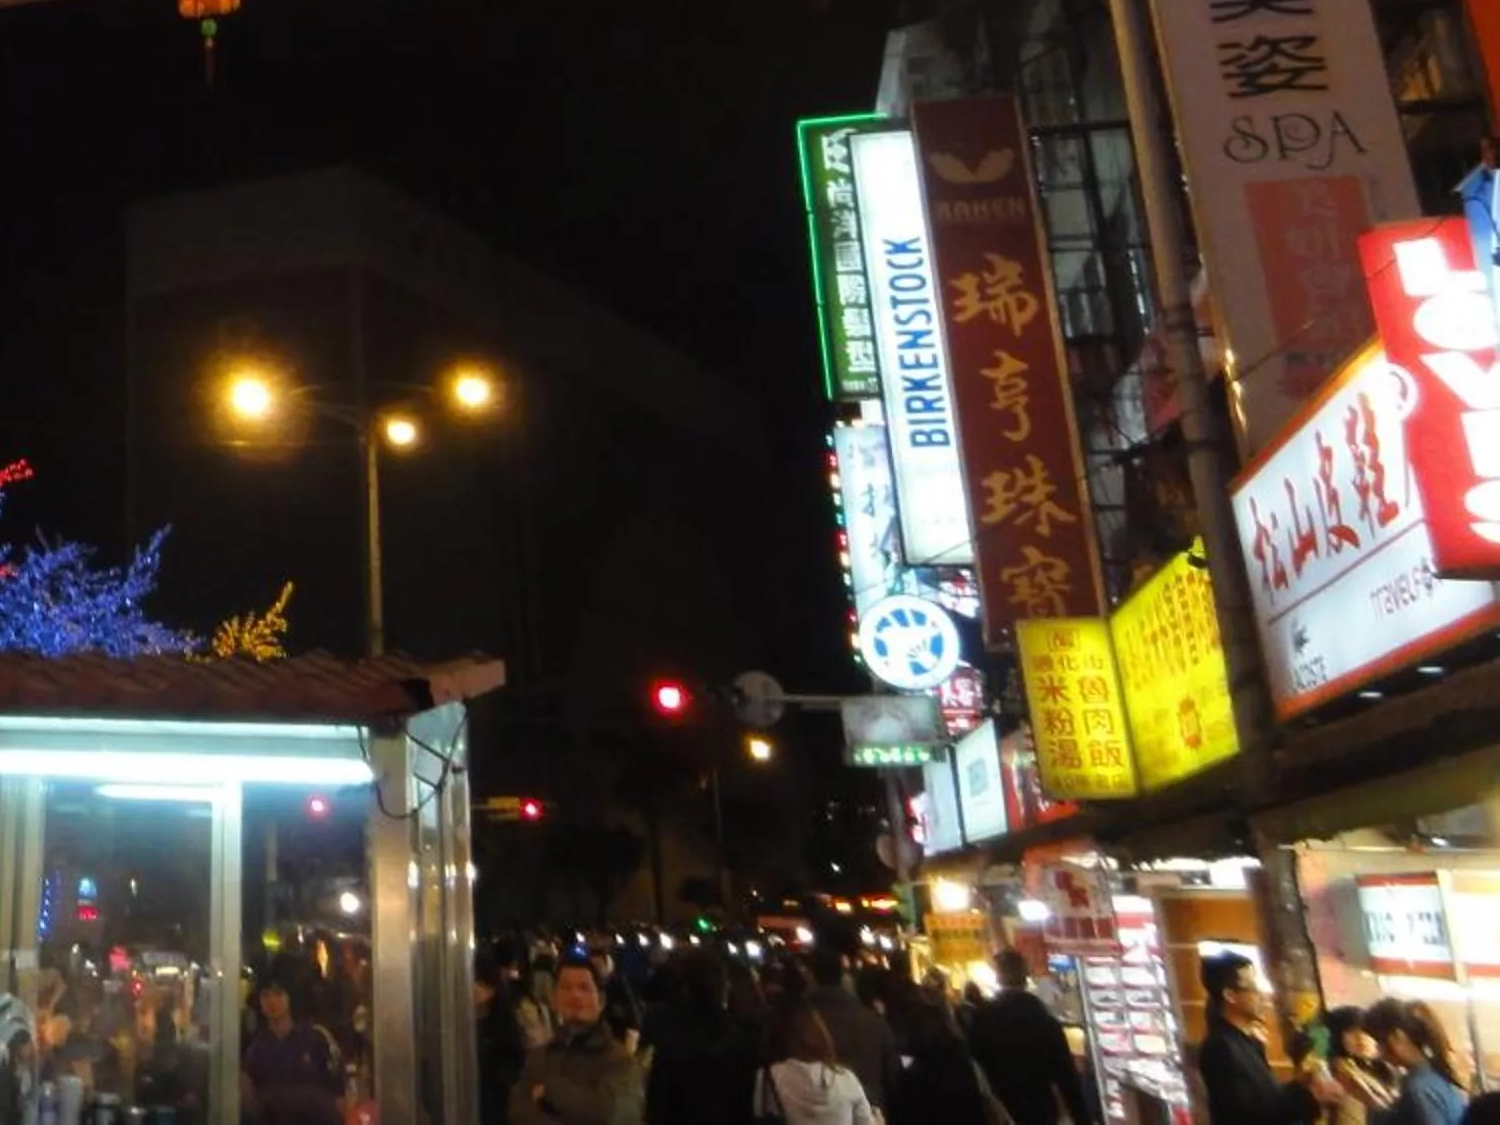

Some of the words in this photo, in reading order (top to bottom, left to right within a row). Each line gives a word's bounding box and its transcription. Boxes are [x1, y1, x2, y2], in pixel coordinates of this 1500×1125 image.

[1222, 109, 1369, 170] SPA
[883, 236, 951, 449] BIRKENSTOCK
[952, 253, 1077, 618] 瑞亨珠寶
